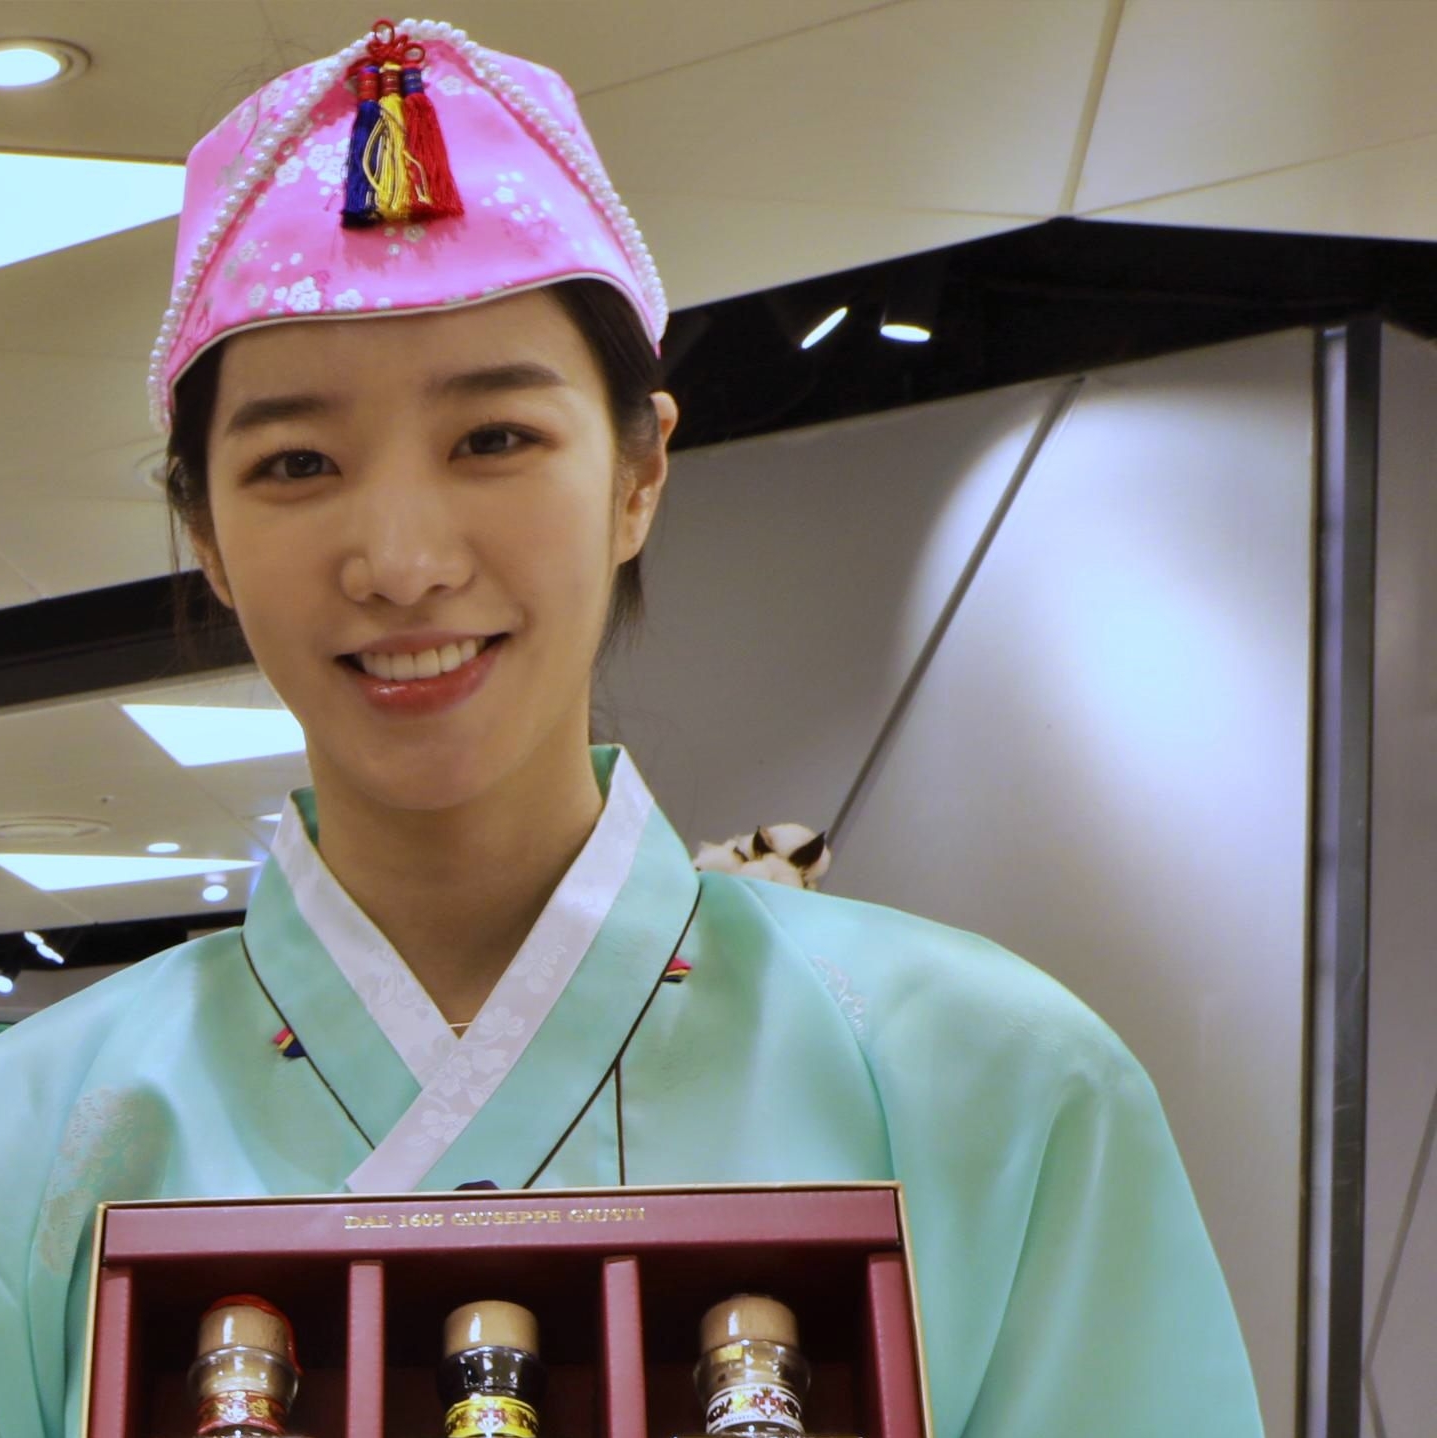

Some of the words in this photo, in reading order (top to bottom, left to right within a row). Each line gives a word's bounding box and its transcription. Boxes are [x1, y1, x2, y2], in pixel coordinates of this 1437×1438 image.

[344, 1215, 392, 1229] DAL
[399, 1214, 444, 1228] 1605
[451, 1210, 562, 1226] GIUSEPPE
[568, 1207, 646, 1223] GIUSTI
